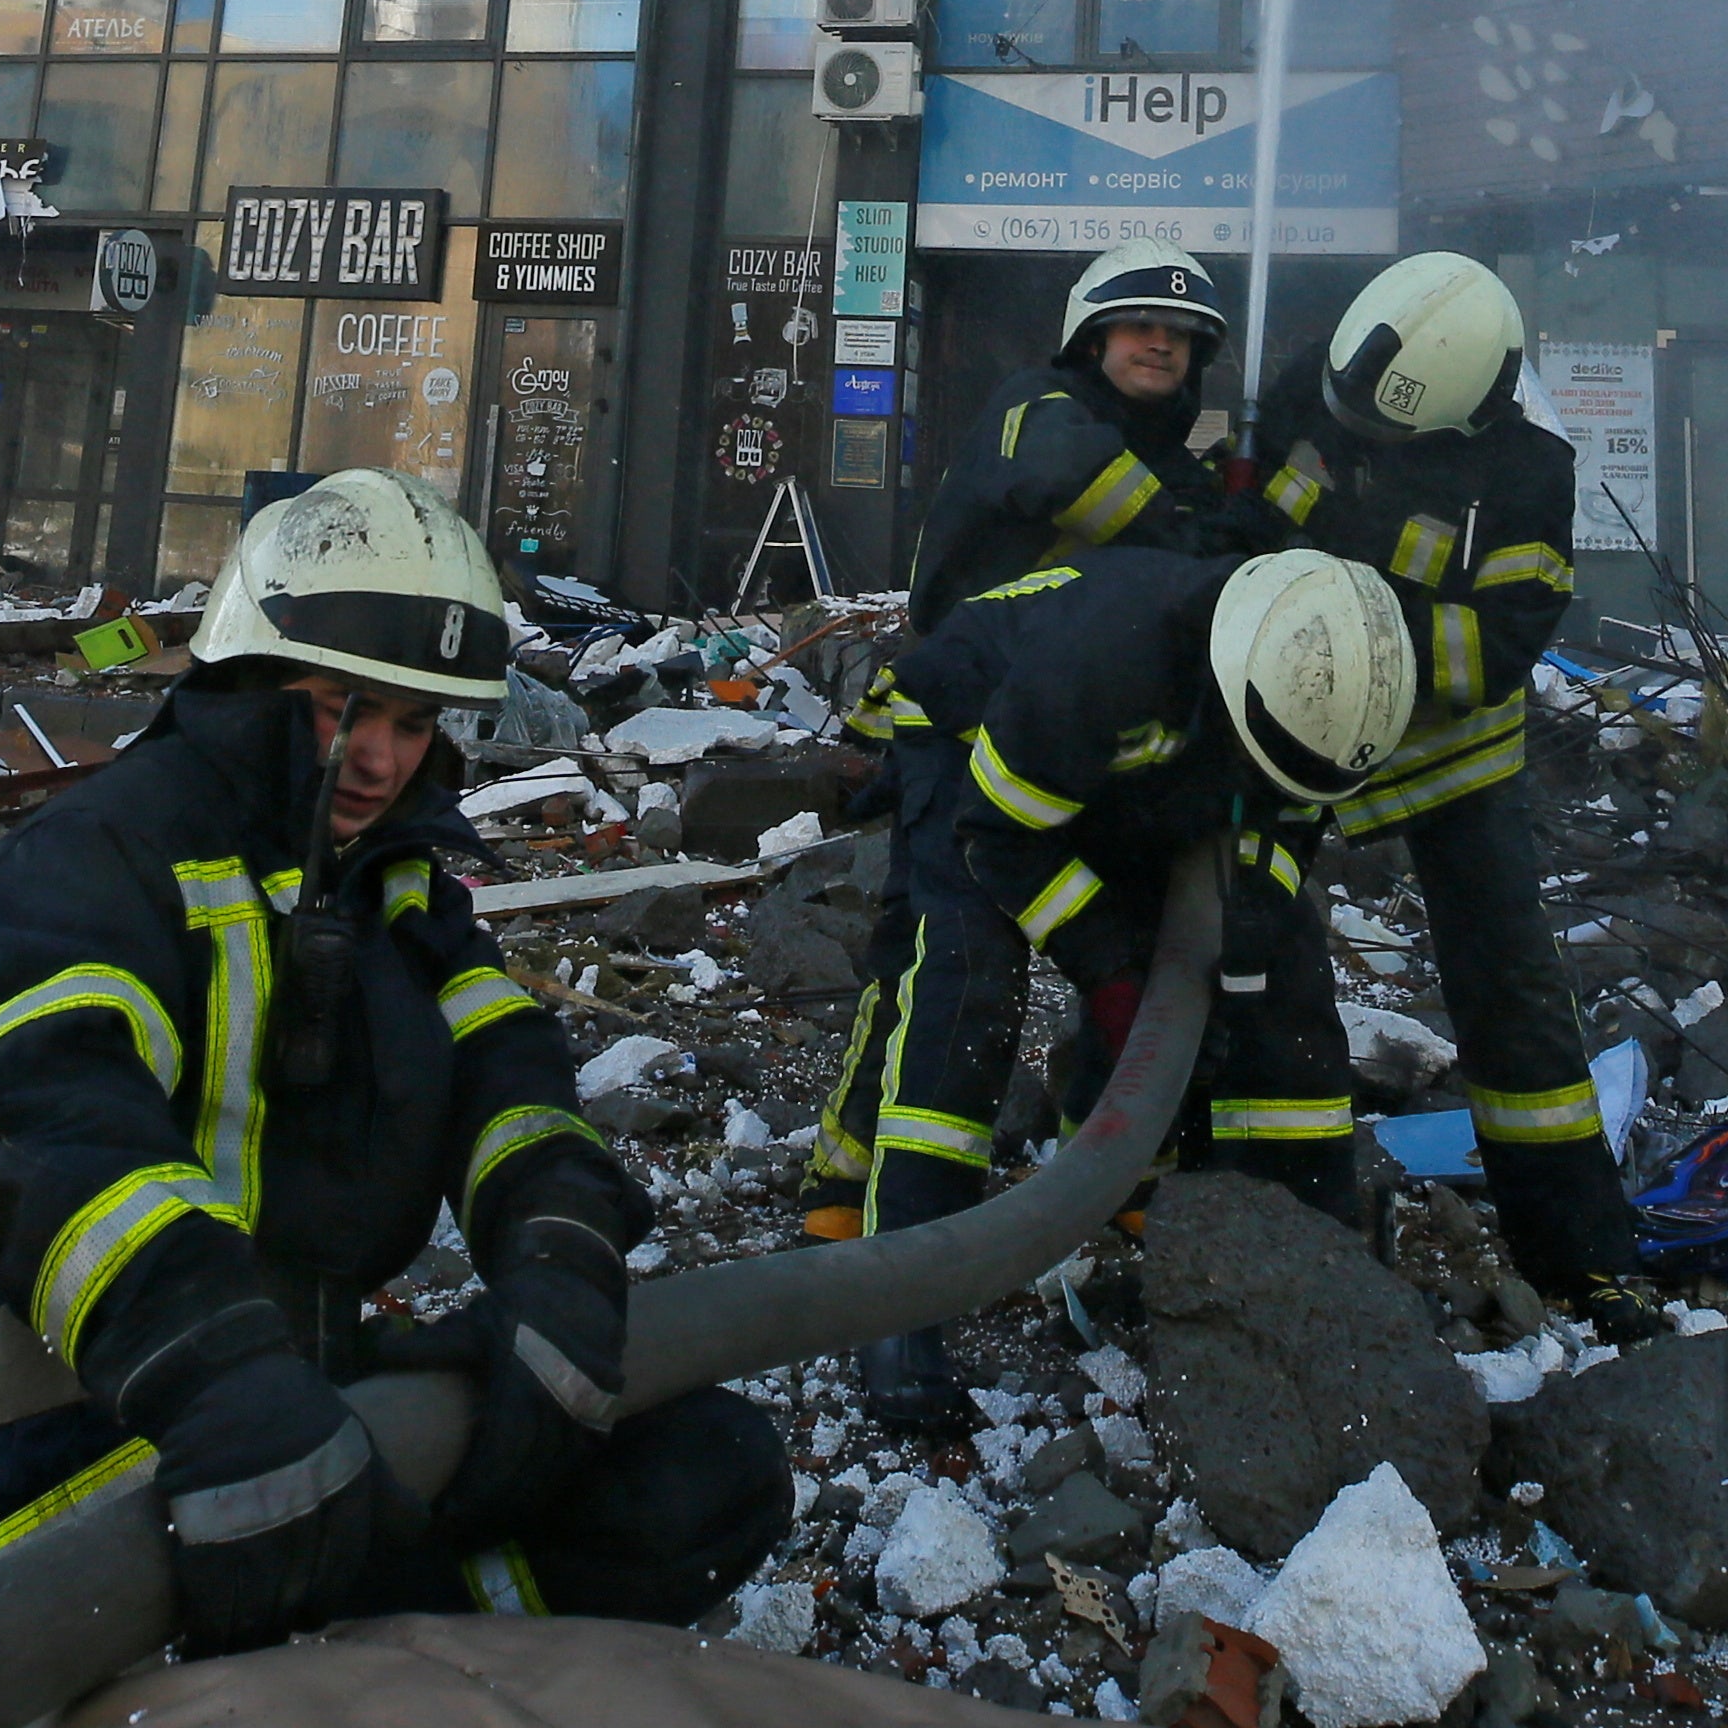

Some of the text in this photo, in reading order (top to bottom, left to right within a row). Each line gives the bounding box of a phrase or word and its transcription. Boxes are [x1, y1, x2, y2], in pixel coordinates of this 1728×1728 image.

[1083, 73, 1228, 135] iHelp
[980, 168, 1349, 194] ремонт сервіс аксуари
[856, 208, 892, 225] SLIM
[227, 198, 425, 285] COZY BAR
[1000, 217, 1060, 245] (067)
[1069, 219, 1111, 241] 156
[1119, 219, 1146, 240] 50
[1154, 220, 1183, 240] 66
[120, 241, 152, 273] COZY
[488, 231, 606, 261] COFFEE SHOP
[854, 236, 904, 255] STUDIO
[728, 249, 822, 277] COZY BAR
[855, 265, 888, 283] KIEV
[496, 264, 597, 293] & YUMMIES
[726, 277, 748, 292] True
[751, 277, 776, 293] Taste
[778, 278, 792, 293] Of
[1170, 270, 1187, 295] 8
[336, 312, 447, 358] COFFEE
[511, 356, 570, 395] Enjoy
[1571, 363, 1623, 376] dediko
[313, 373, 362, 398] DESSERT
[1397, 376, 1417, 395] 26
[1389, 391, 1412, 410] 23
[737, 428, 764, 450] COZY
[1606, 437, 1649, 455] 15%
[503, 463, 525, 474] VISA
[505, 521, 567, 542] friendly
[440, 603, 467, 660] 8
[1349, 741, 1376, 771] 8
